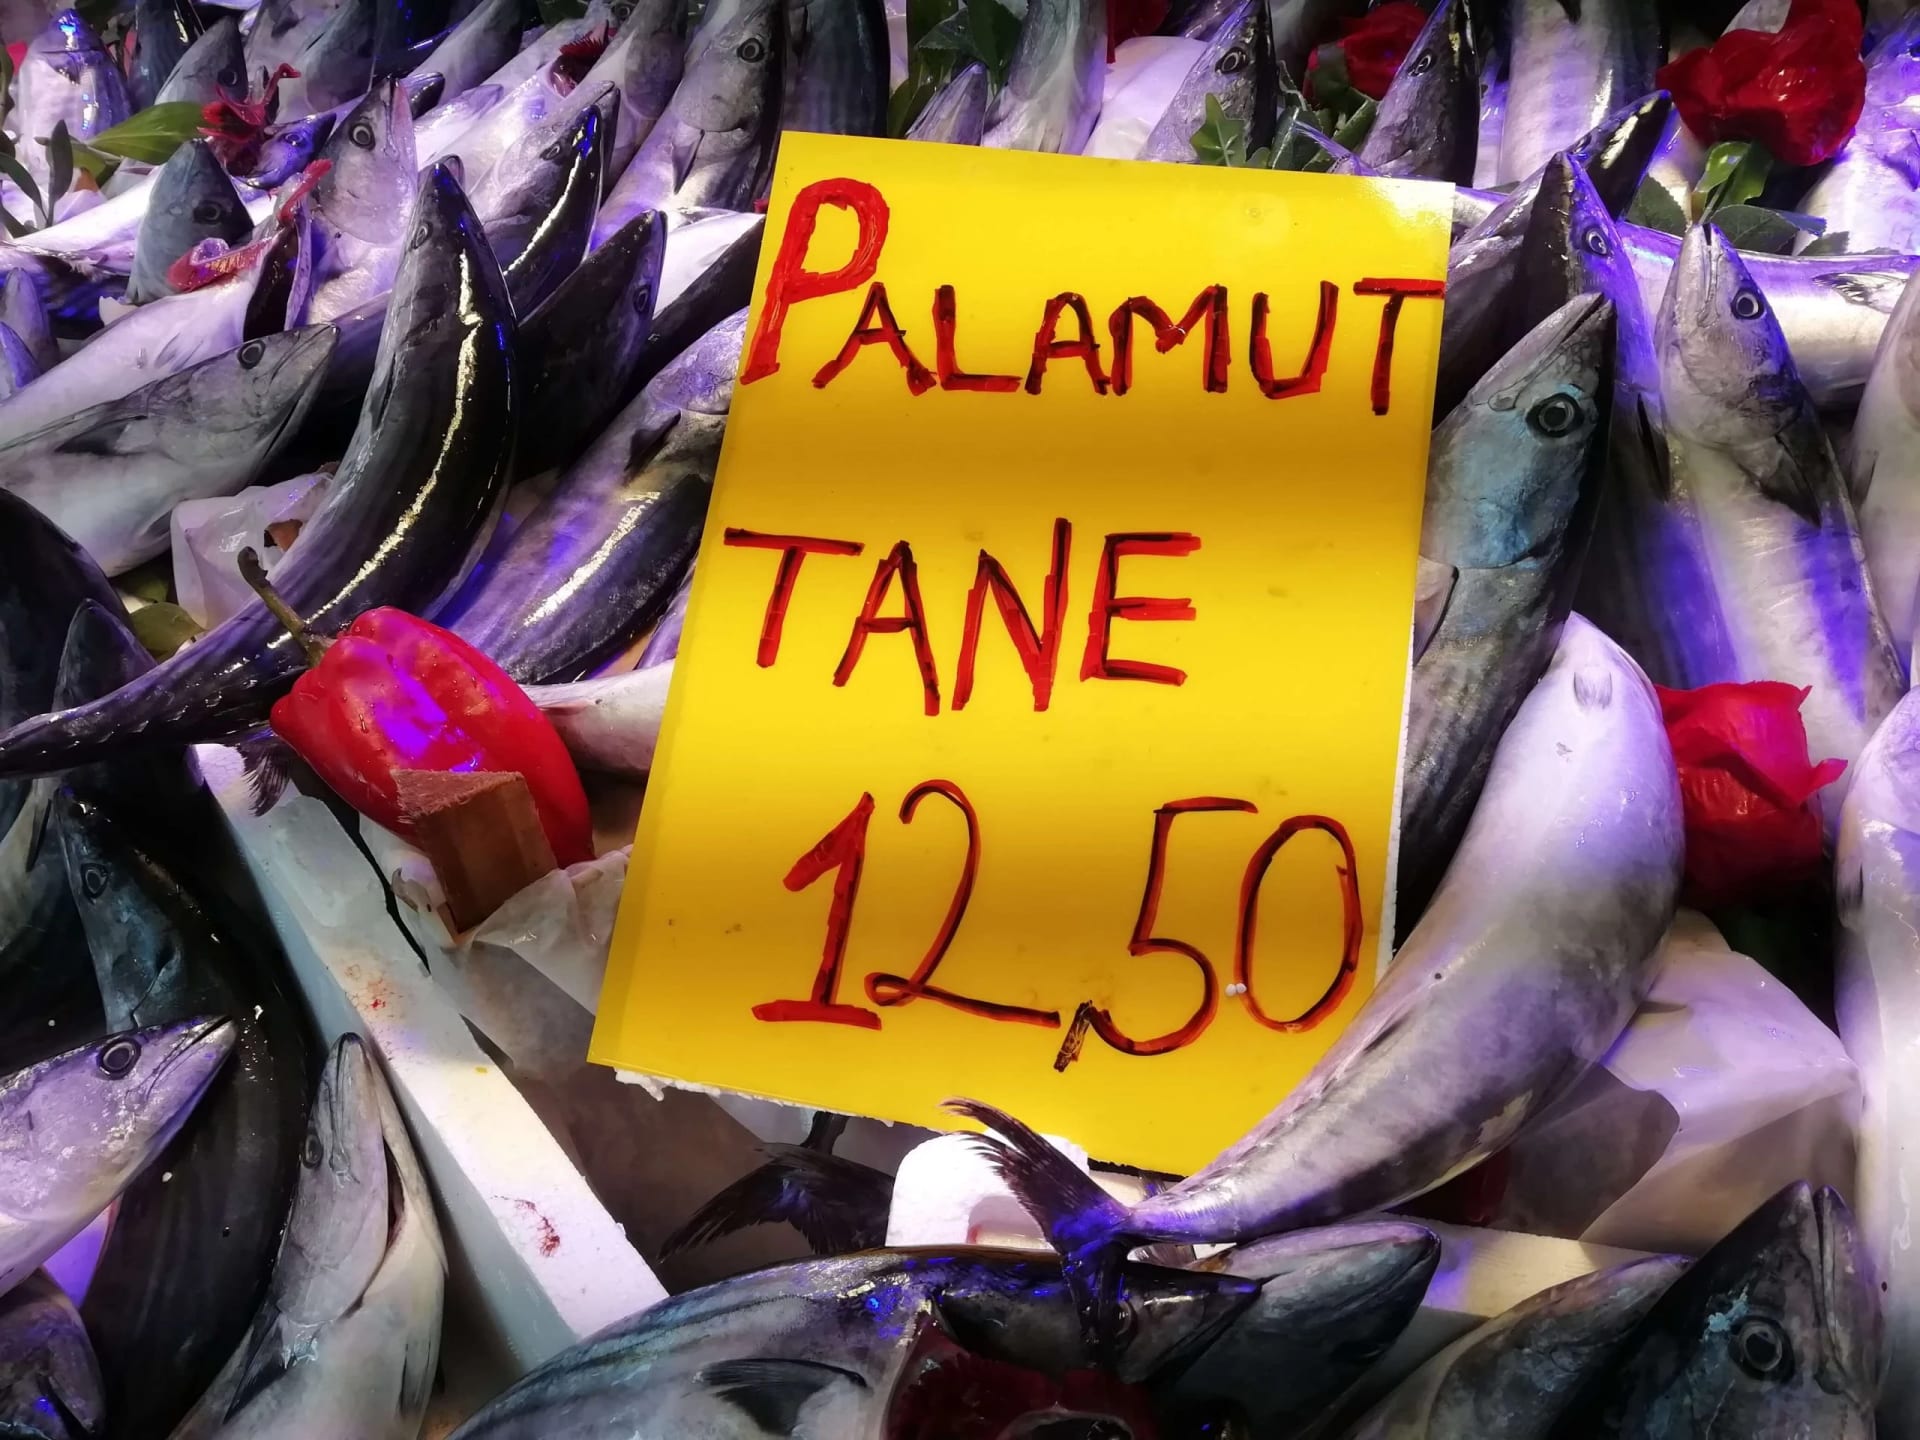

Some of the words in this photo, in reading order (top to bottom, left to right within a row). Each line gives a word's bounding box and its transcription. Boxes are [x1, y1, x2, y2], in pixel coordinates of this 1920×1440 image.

[739, 177, 1445, 416] PALAMUT
[723, 517, 1202, 717] TANE
[751, 778, 1363, 1073] 12,50
